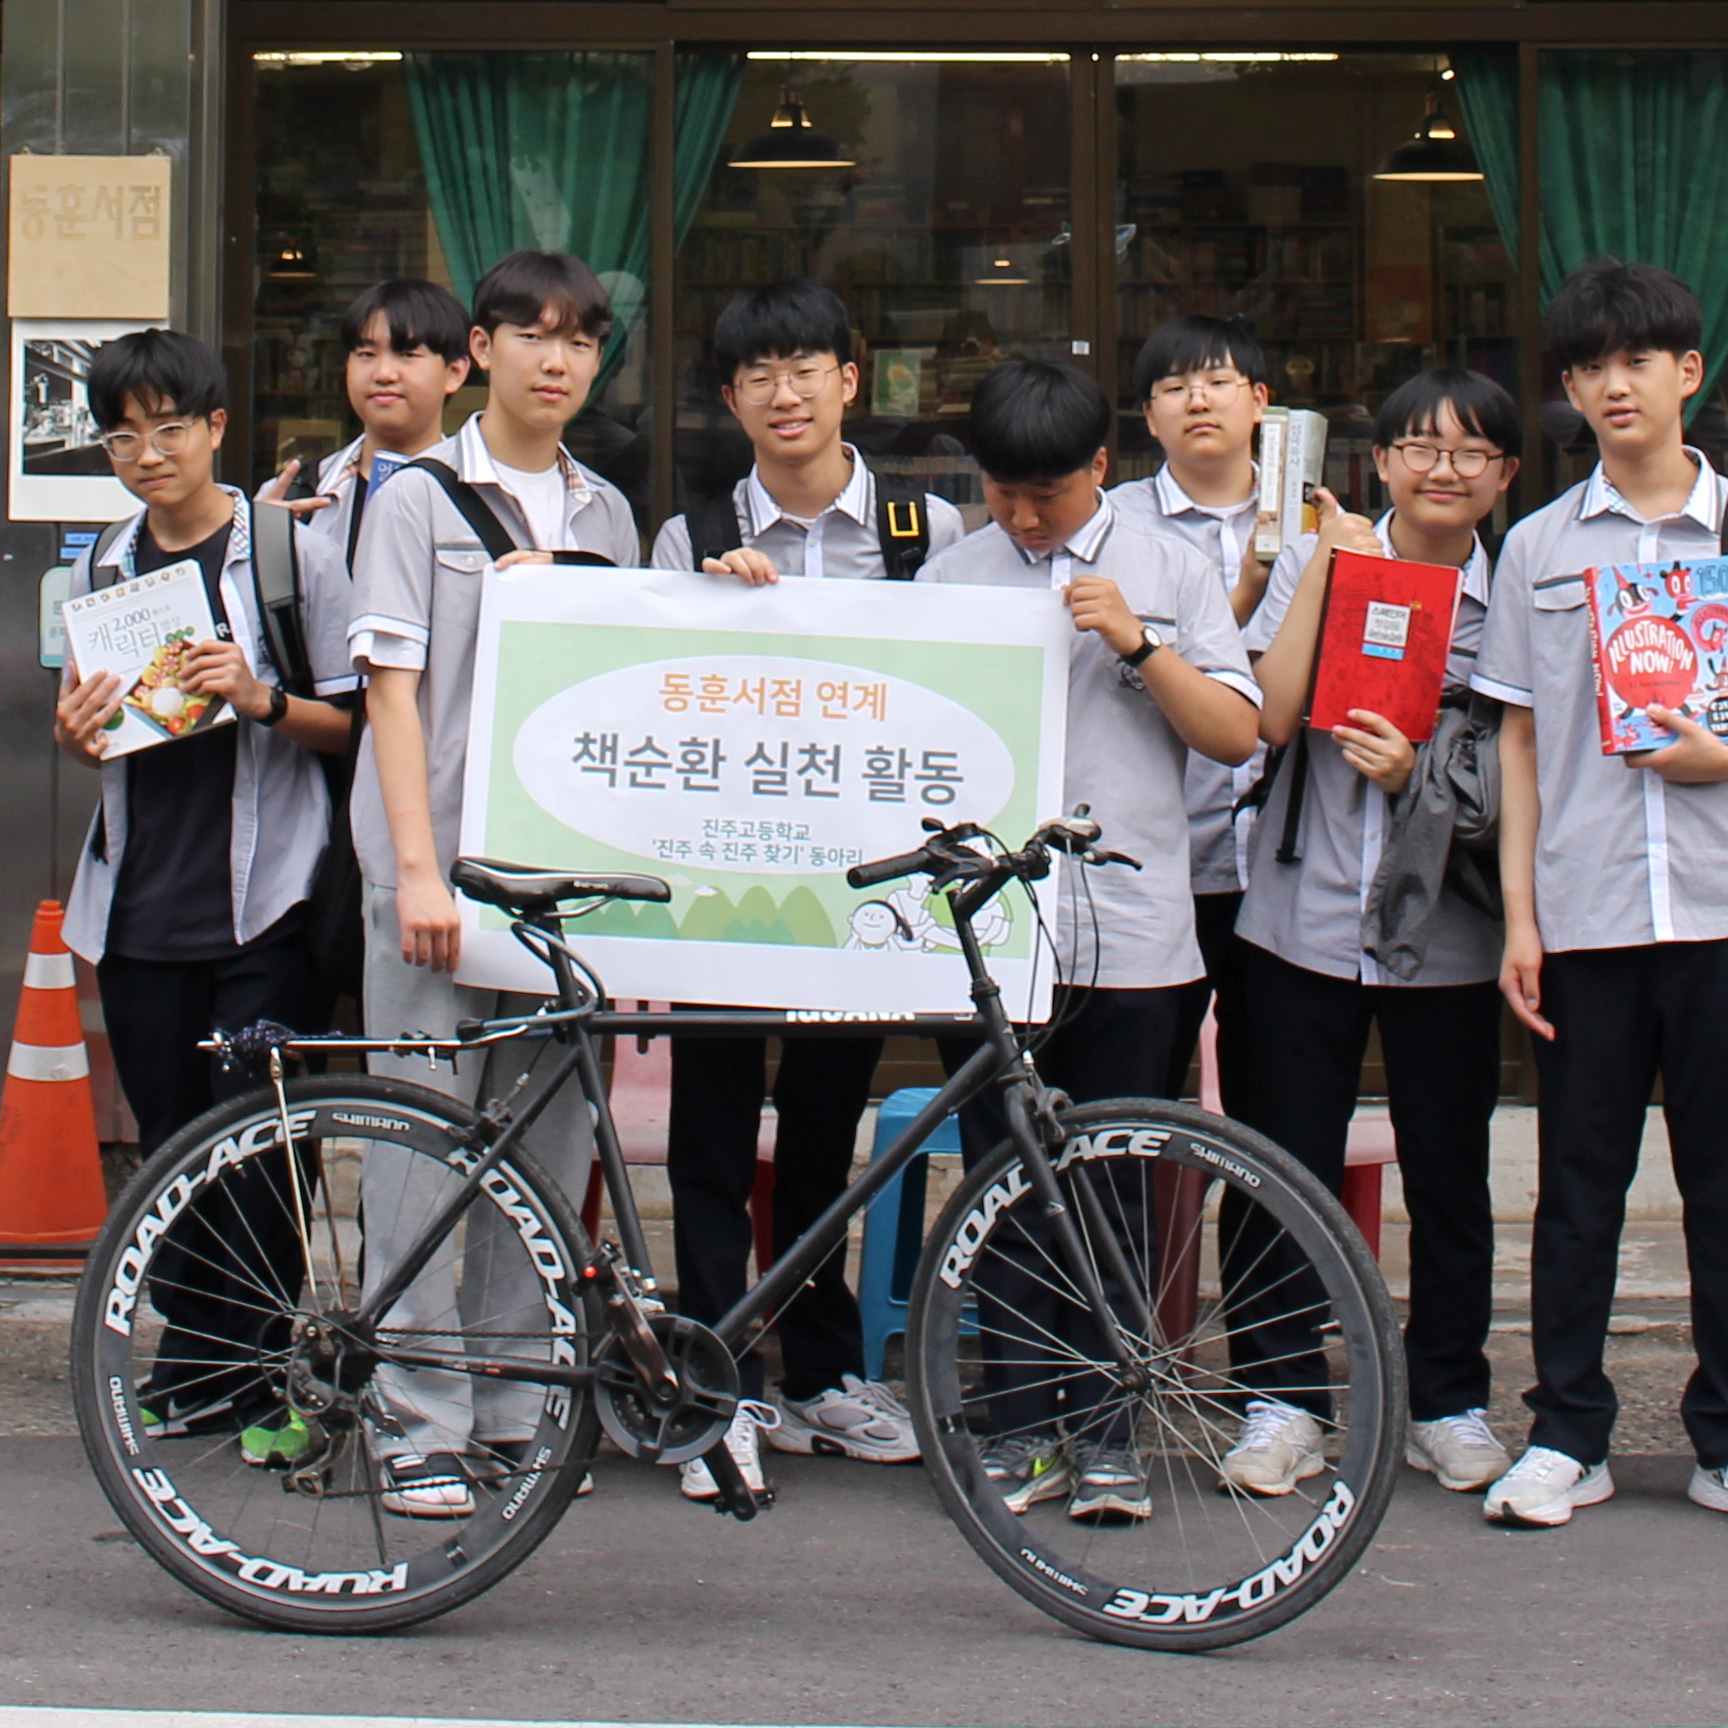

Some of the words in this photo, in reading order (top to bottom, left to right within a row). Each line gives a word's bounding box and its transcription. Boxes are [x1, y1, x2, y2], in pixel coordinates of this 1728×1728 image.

[18, 183, 162, 242] 동훈서점
[1608, 620, 1694, 674] ILLUSTRATION
[658, 673, 803, 718] 동훈서점
[815, 680, 889, 722] 연계
[571, 731, 727, 793] 책순환
[743, 741, 842, 799] 실천
[860, 745, 964, 806] 활동
[699, 841, 716, 861] 속
[722, 842, 758, 863] 진주
[808, 847, 864, 868] 동아리
[701, 818, 812, 842] 진주고등학교
[104, 1110, 317, 1337] ROAD-ACE
[1103, 1480, 1356, 1623] ROAD-ACE
